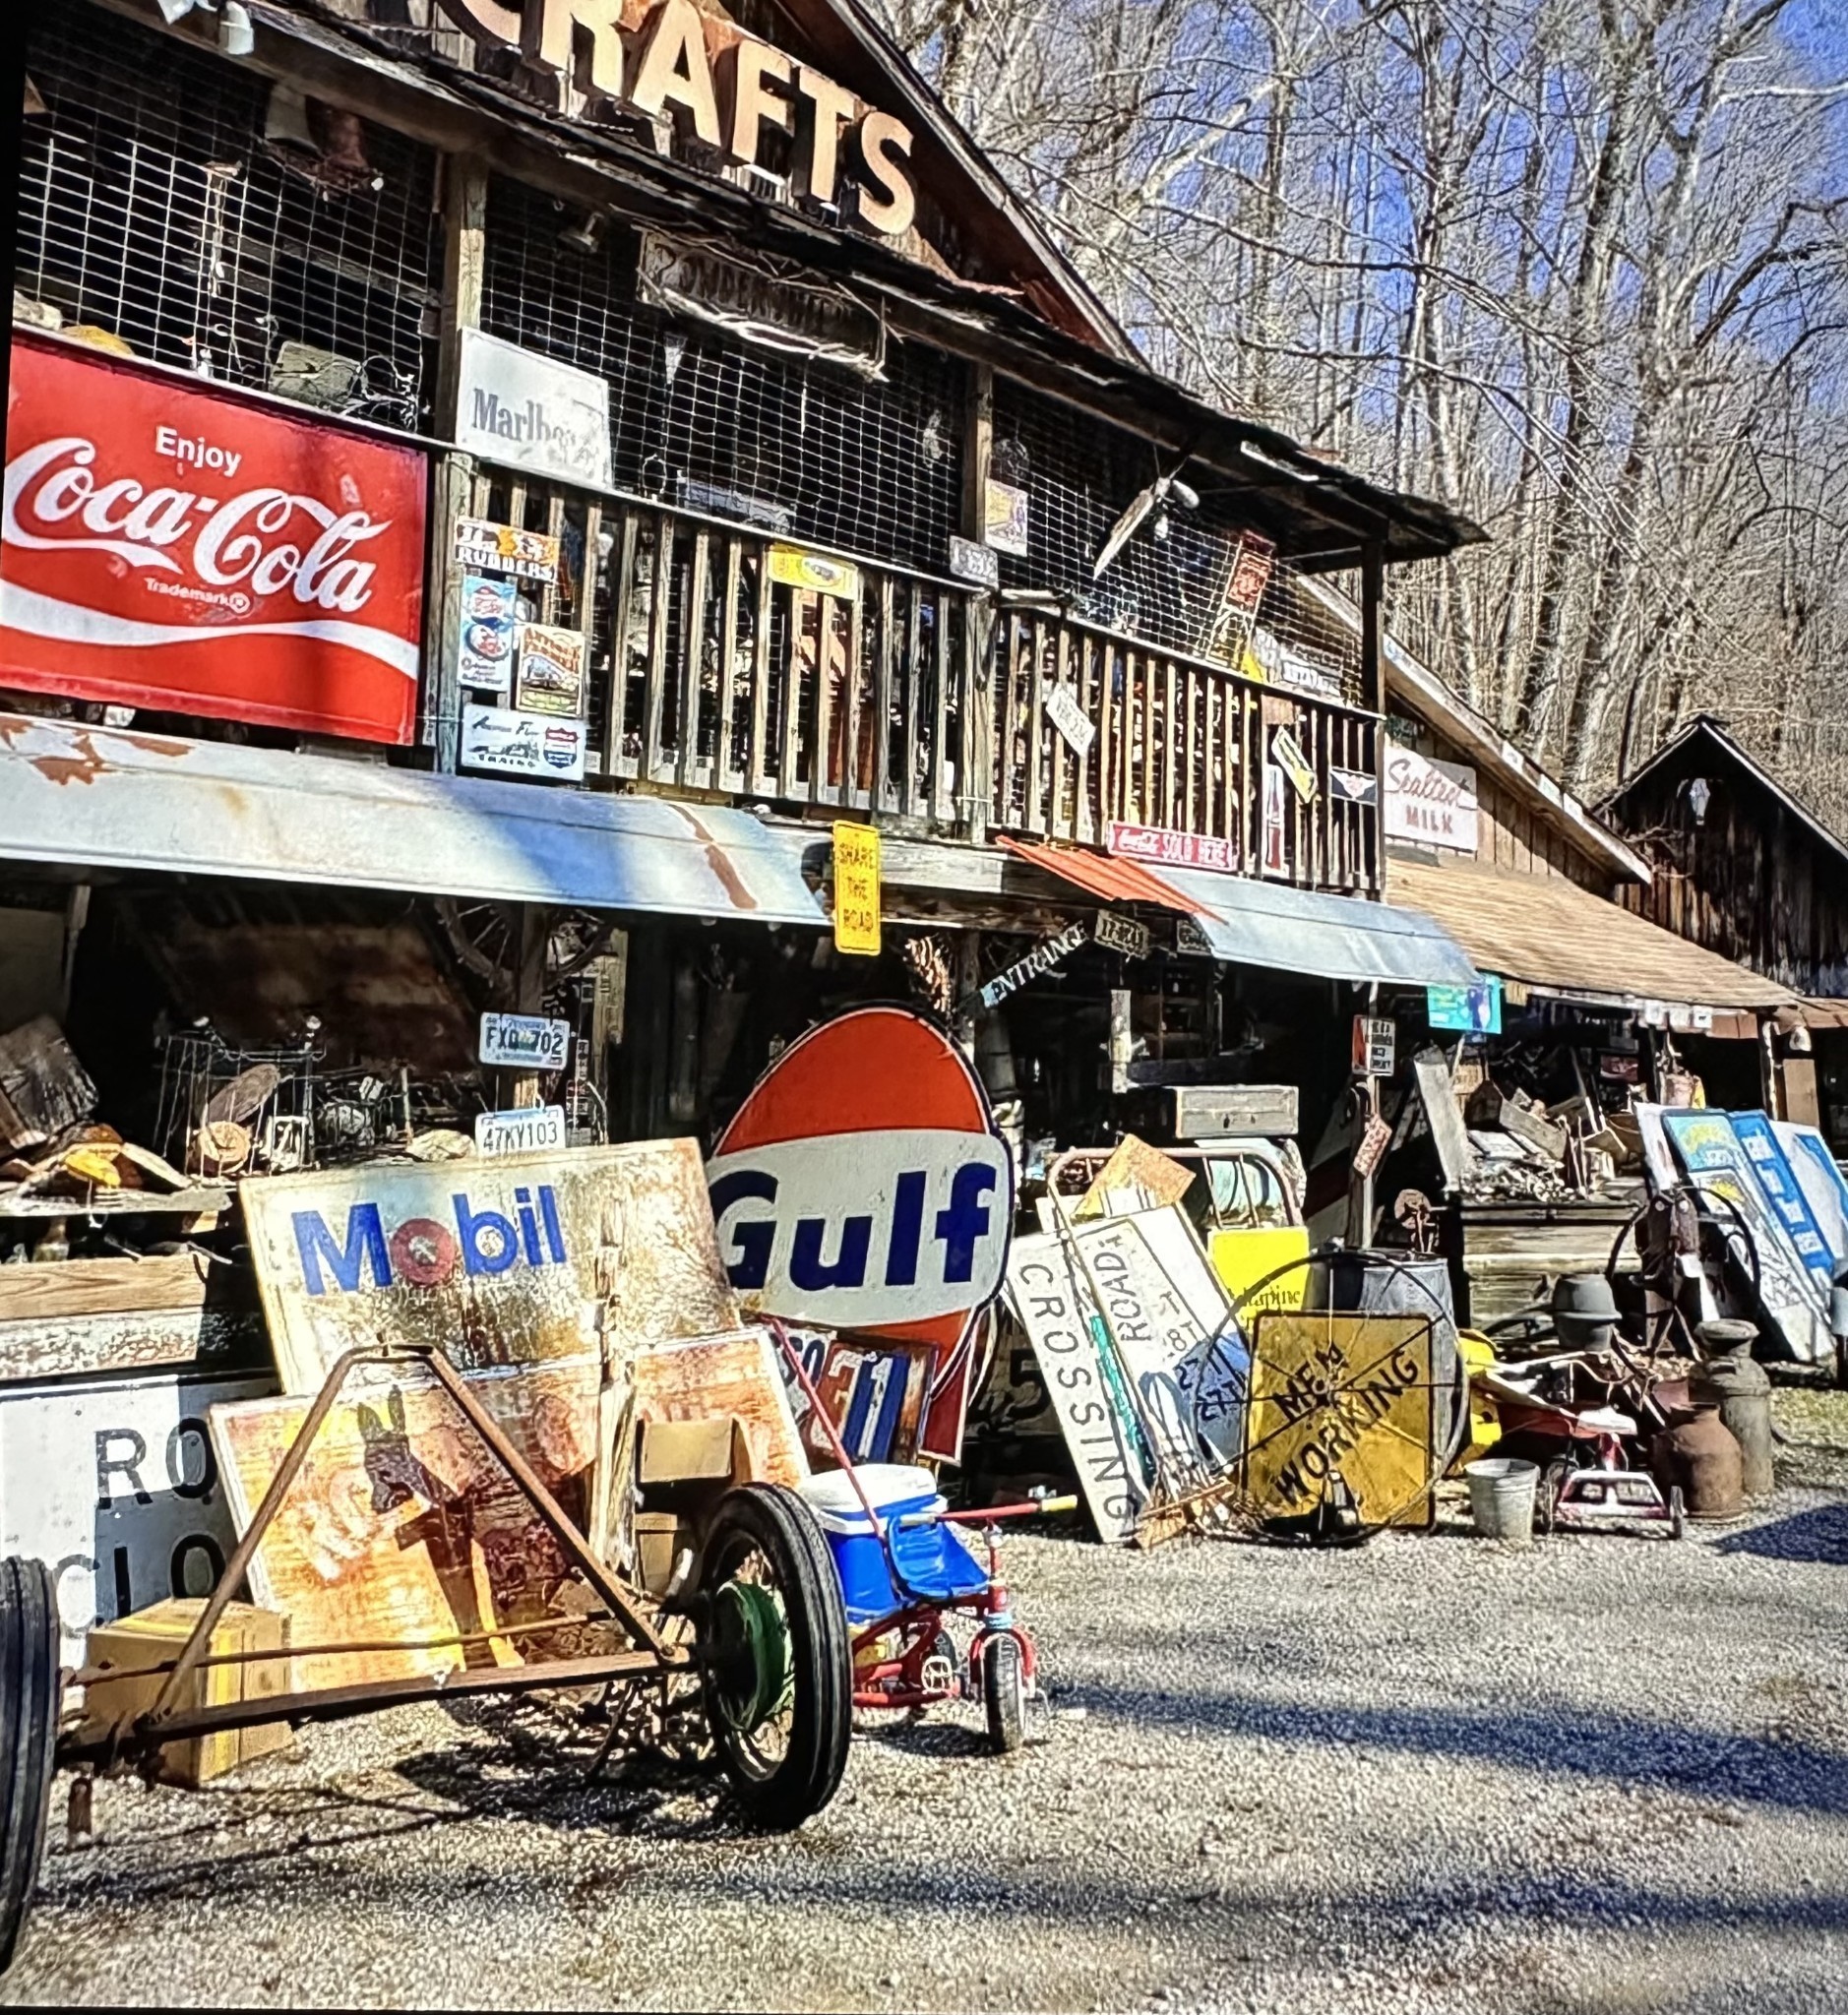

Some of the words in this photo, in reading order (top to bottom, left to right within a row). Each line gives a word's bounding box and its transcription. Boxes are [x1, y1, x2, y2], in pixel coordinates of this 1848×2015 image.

[464, 0, 915, 235] RAFTS
[155, 425, 242, 478] Enjoy
[2, 437, 393, 613] Coca-Cola
[1406, 804, 1453, 834] MILK
[290, 1185, 566, 1296] Mobil
[709, 1161, 997, 1291] Gulf
[1092, 1251, 1151, 1342] ROAD
[1019, 1263, 1140, 1521] CROSSING
[1275, 1350, 1419, 1506] WORKING
